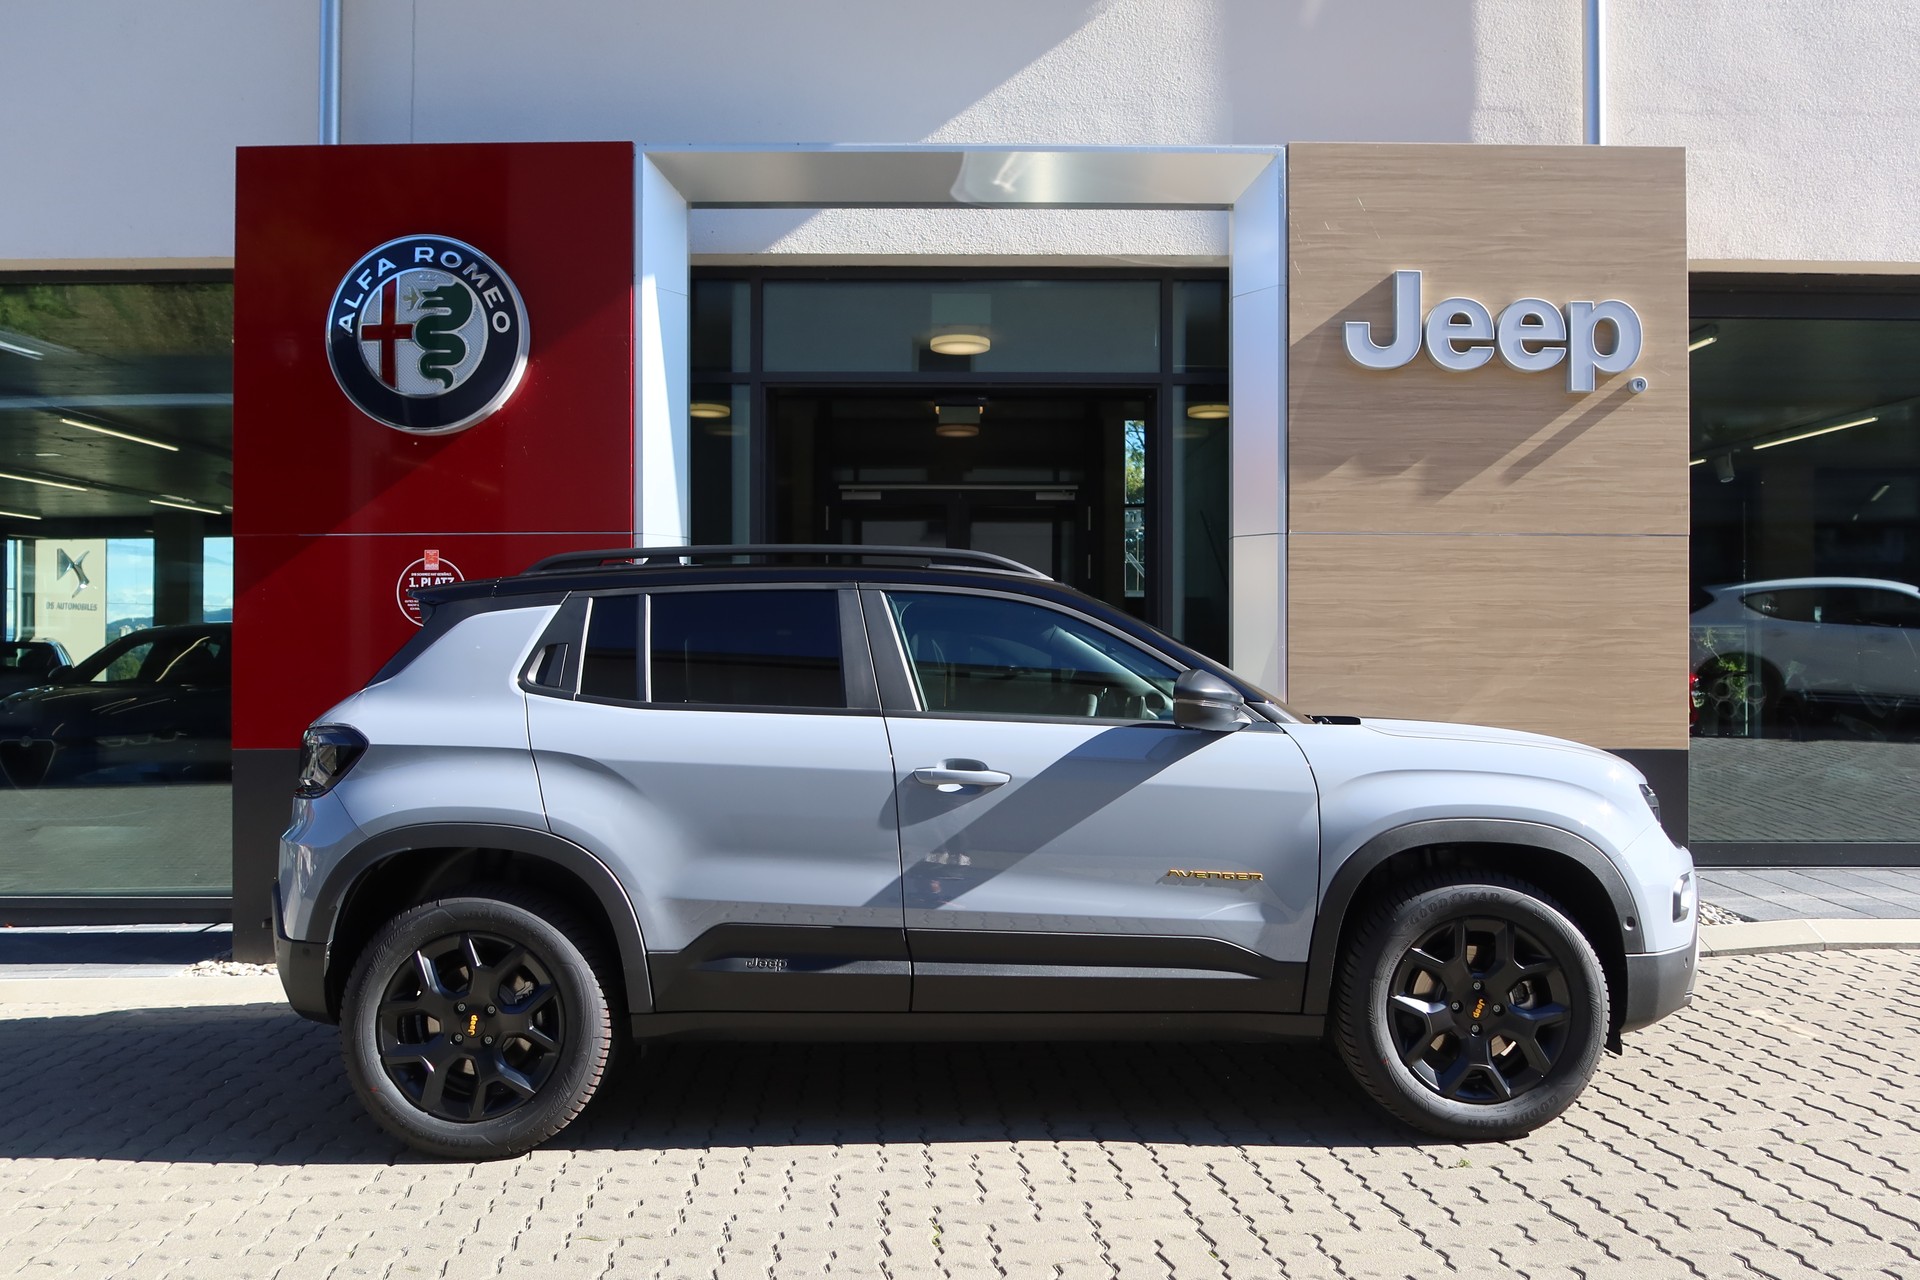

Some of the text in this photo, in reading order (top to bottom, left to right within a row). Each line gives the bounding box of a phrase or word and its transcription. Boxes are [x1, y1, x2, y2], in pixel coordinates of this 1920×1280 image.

[338, 246, 511, 334] ALFA ROMEO
[1342, 269, 1643, 393] Jeep
[46, 601, 98, 611] DS AUTOMOBILES
[1167, 869, 1263, 881] AVENGER
[745, 957, 788, 973] Jeep
[1471, 998, 1485, 1018] Jeep
[467, 1014, 478, 1036] Jeep
